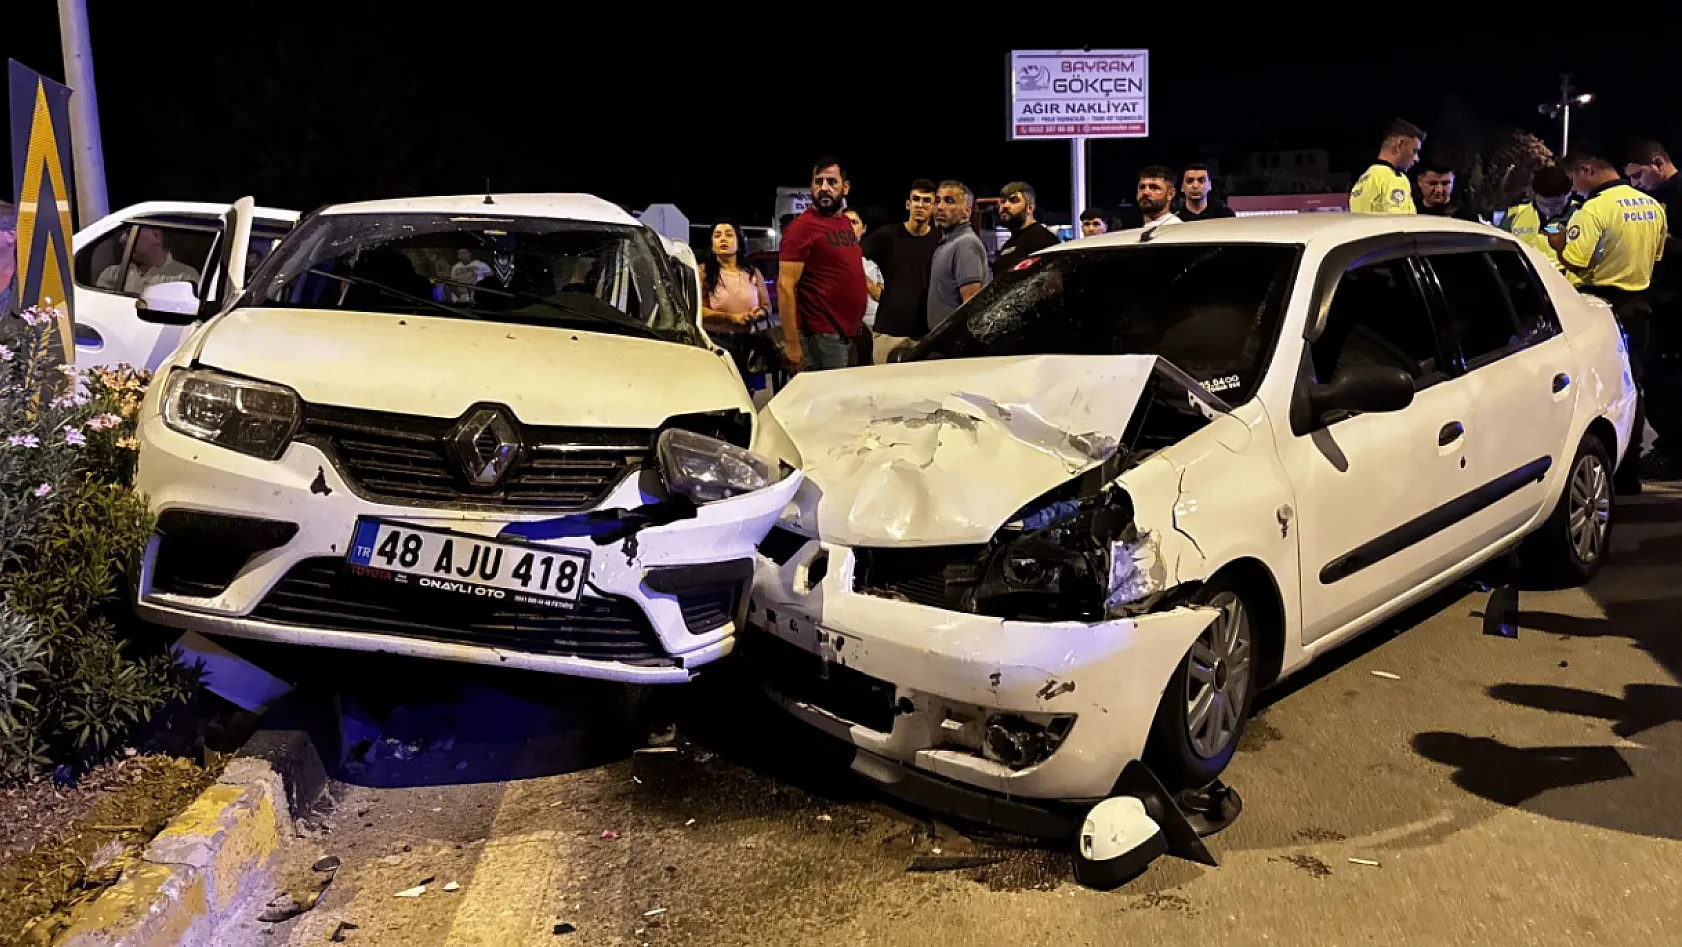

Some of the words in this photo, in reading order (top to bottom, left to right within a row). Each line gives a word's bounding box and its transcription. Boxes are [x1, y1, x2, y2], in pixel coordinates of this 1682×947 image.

[1061, 61, 1135, 73] BAYRAM
[1053, 74, 1143, 97] GÖKÇEN
[1022, 102, 1061, 114] AĞIR
[1065, 101, 1139, 113] NAKLİYAT
[357, 546, 371, 558] TR
[377, 530, 423, 568] 48
[434, 539, 504, 581] AJU
[512, 552, 578, 594] 418
[351, 565, 392, 580] TOYOTA
[475, 586, 506, 599] OTO
